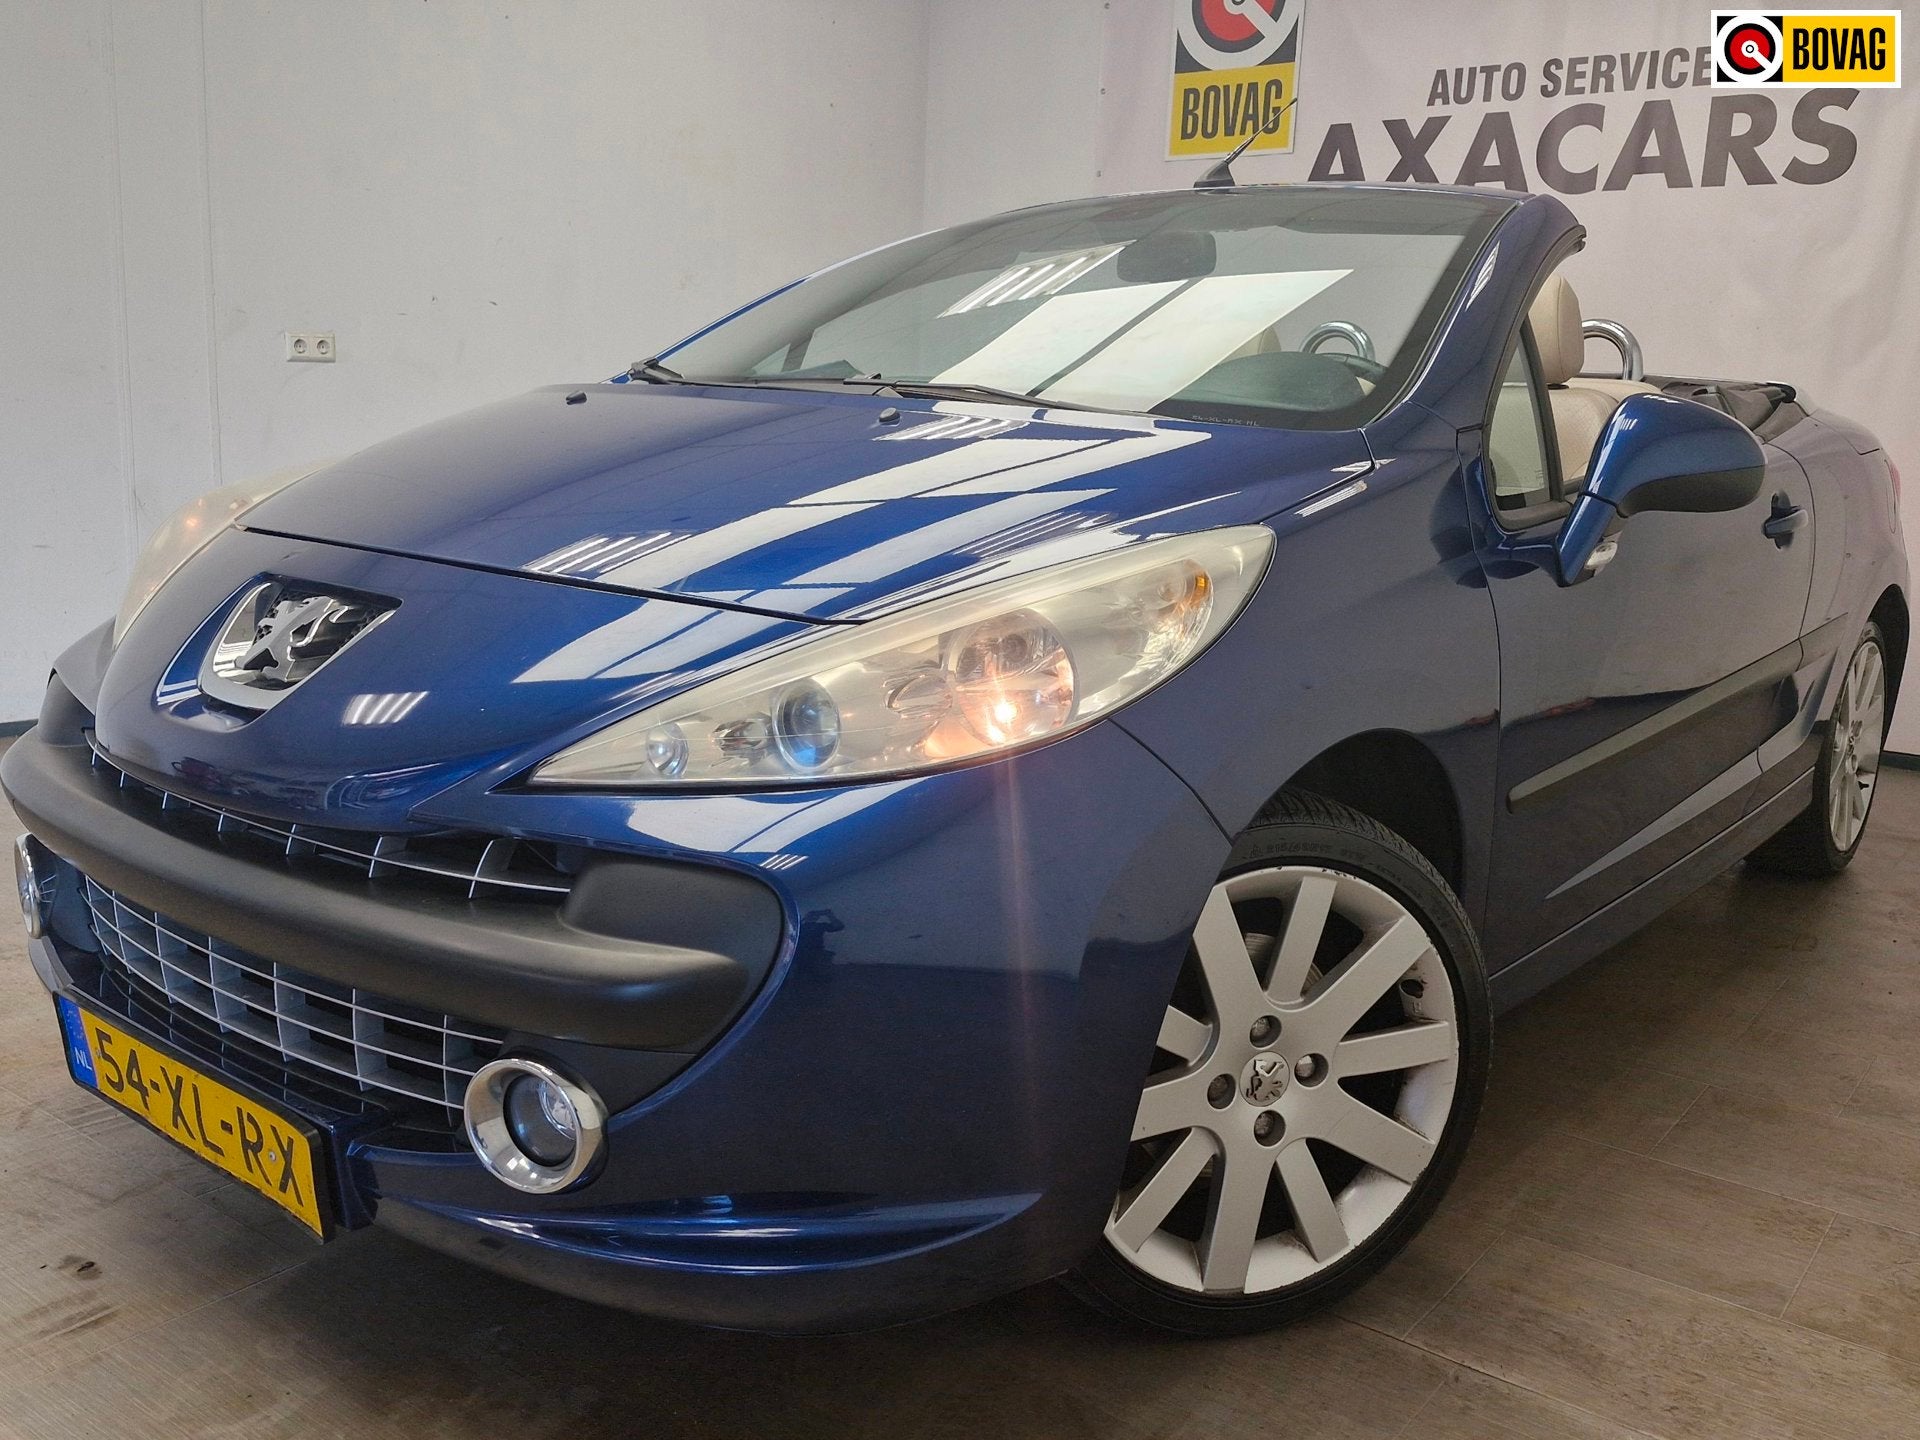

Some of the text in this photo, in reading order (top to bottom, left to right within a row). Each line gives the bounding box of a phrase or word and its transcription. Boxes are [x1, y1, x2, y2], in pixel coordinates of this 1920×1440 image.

[1426, 46, 1711, 106] AUTO SERVICE
[1181, 78, 1284, 141] BOVAG
[1307, 87, 1861, 195] AXACARS
[74, 1047, 93, 1072] NL
[95, 1027, 304, 1208] 54-XL-RX
